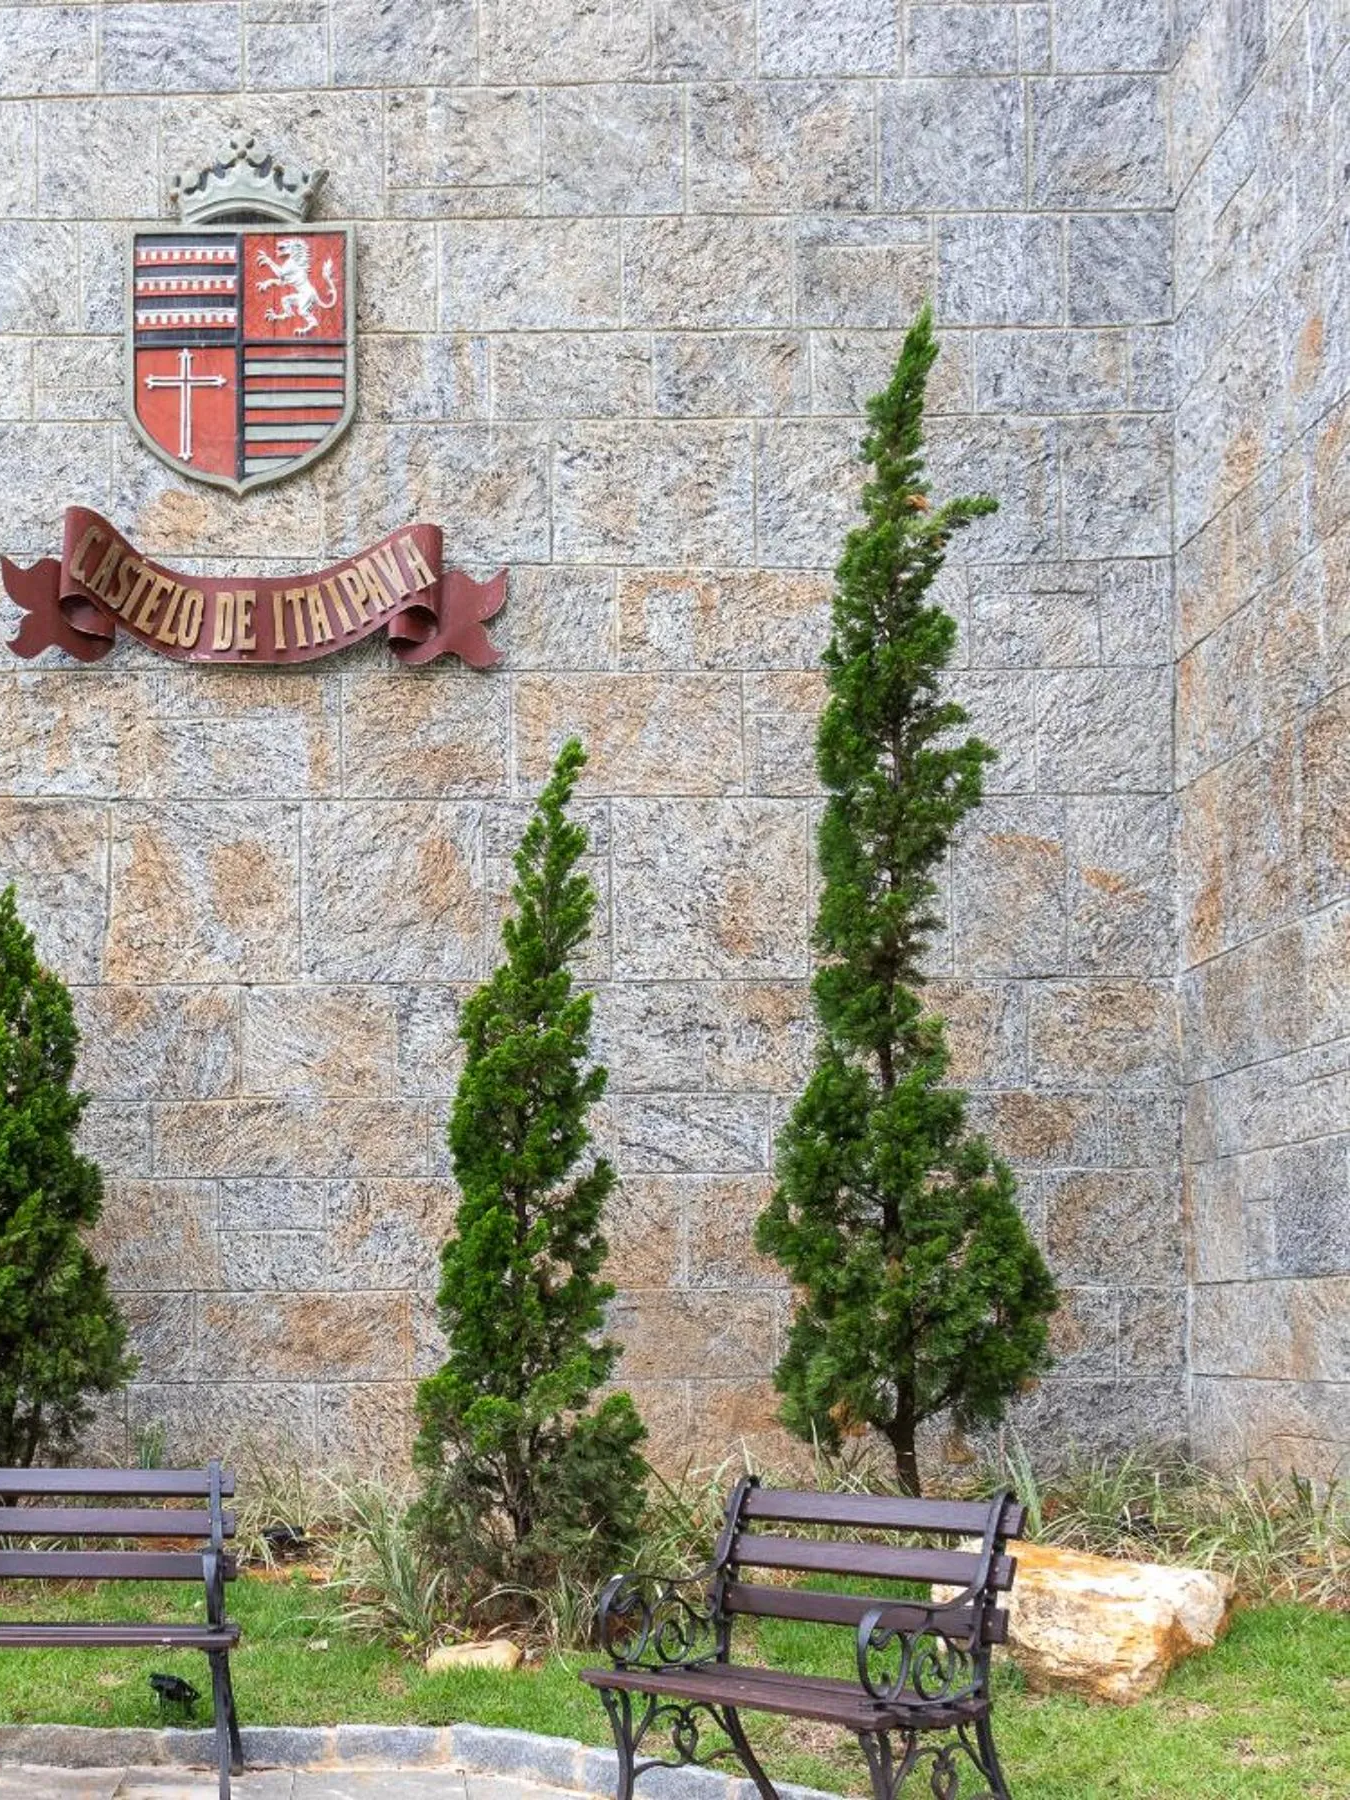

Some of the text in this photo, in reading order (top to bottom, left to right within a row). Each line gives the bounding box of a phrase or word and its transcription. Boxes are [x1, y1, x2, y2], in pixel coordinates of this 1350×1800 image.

[70, 525, 437, 652] CASTELO DE ITAIPAVA
